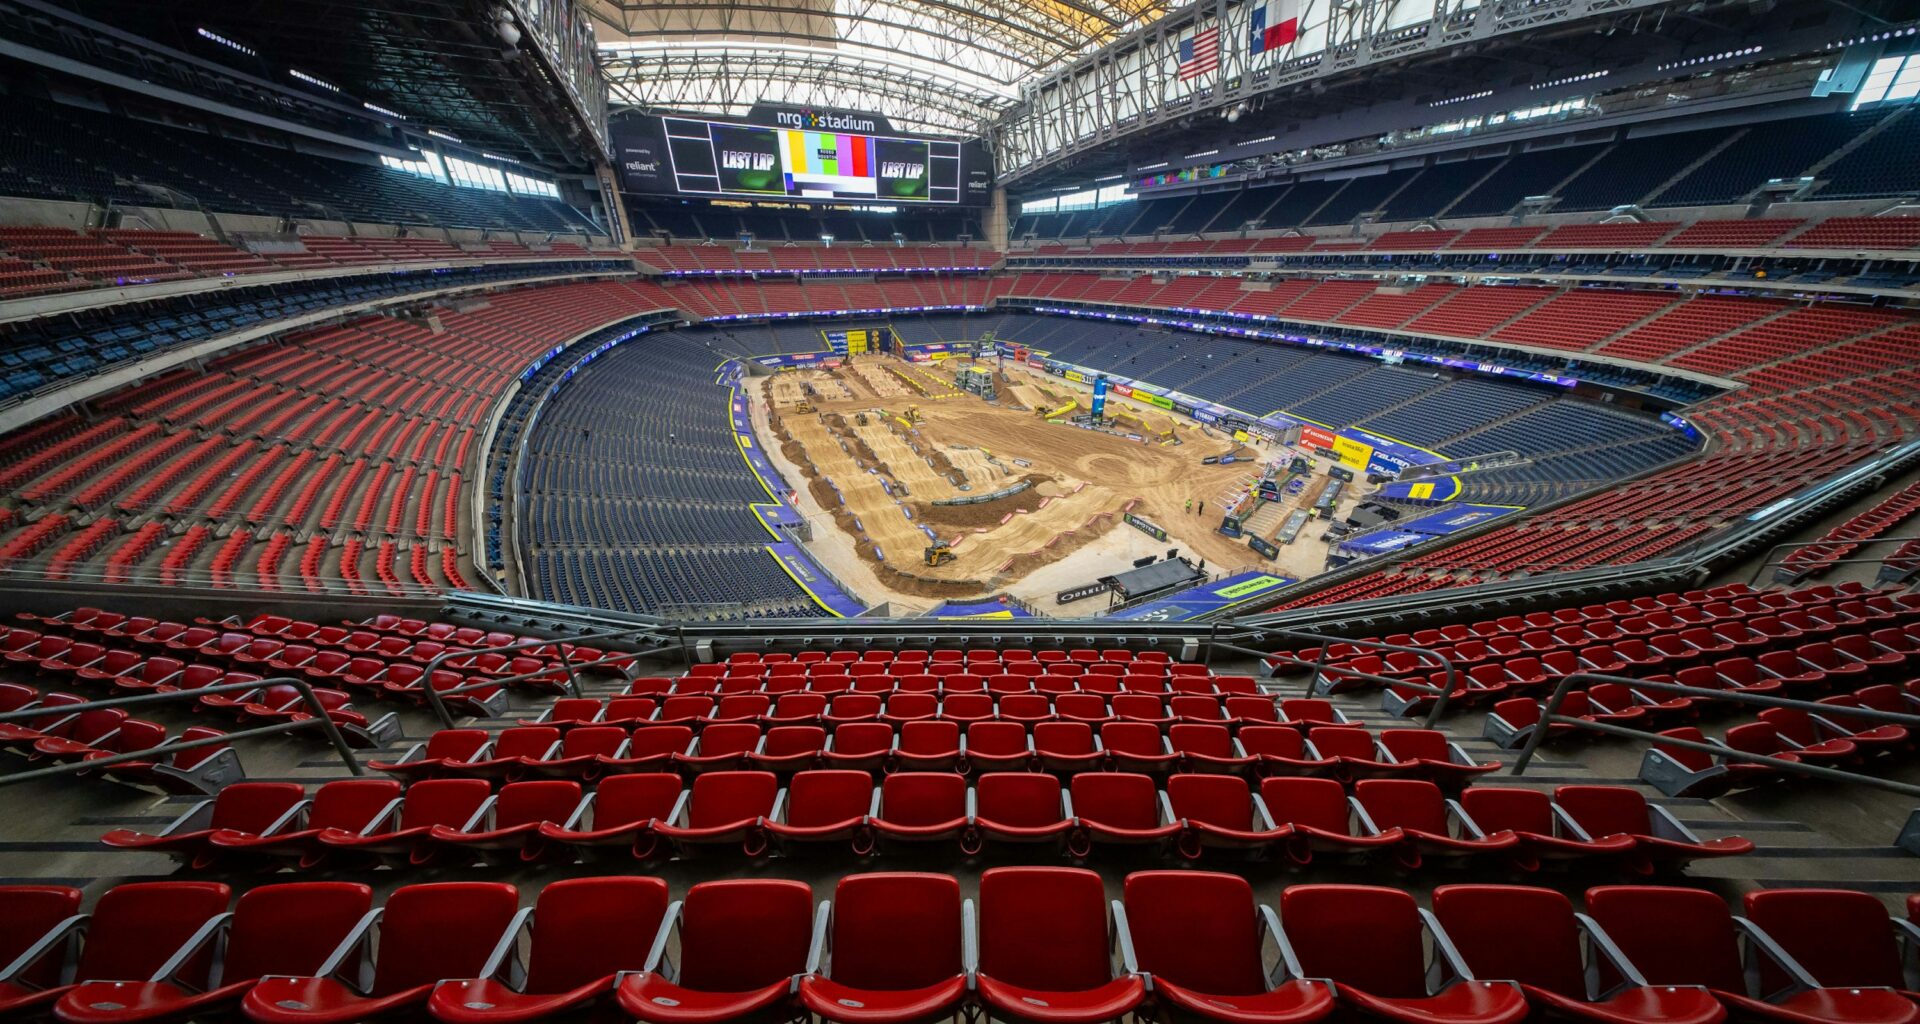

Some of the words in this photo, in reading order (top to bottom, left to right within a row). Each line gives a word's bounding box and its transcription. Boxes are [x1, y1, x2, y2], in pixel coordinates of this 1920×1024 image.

[777, 111, 802, 129] nrg
[818, 114, 875, 132] stadium
[625, 160, 656, 171] reliant
[722, 150, 751, 170] LAST
[752, 152, 775, 171] LAP
[881, 161, 905, 179] LAST
[905, 163, 924, 180] LAP
[1477, 363, 1492, 373] LAST
[1492, 365, 1504, 374] LAP
[1310, 430, 1334, 443] HONDA
[1373, 451, 1410, 468] FALKEN
[1131, 517, 1156, 534] MONSTER
